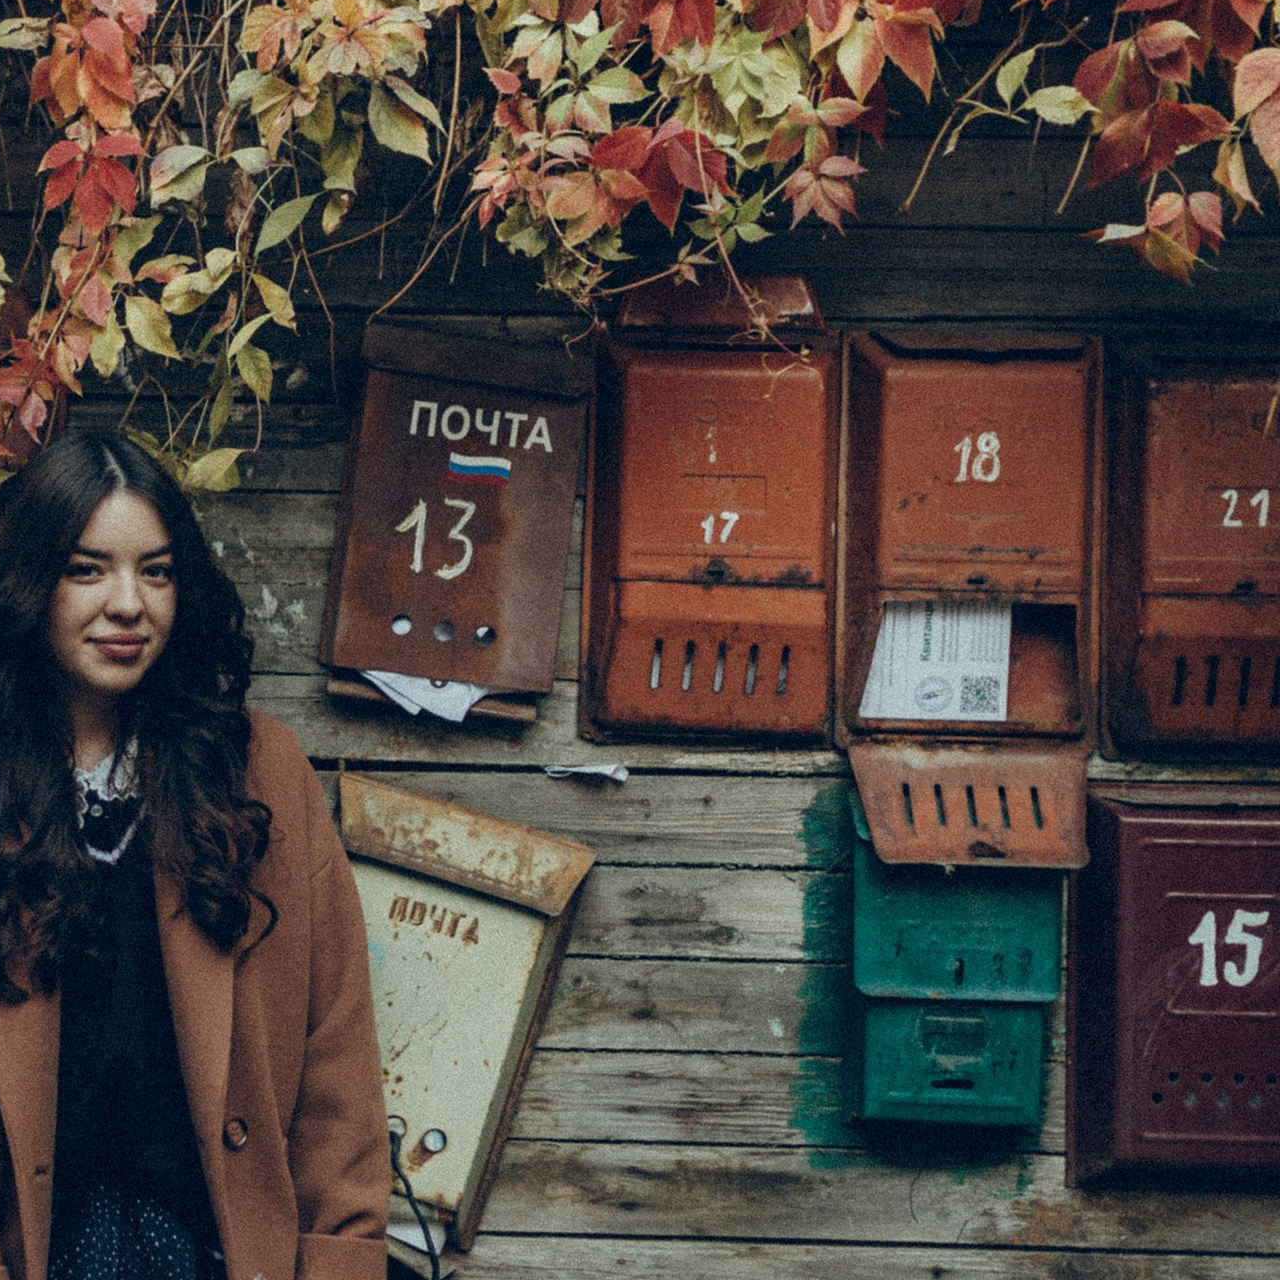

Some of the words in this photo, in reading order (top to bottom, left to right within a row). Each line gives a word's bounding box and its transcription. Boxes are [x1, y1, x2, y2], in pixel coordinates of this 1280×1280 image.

[409, 401, 553, 452] ПОЧТА
[954, 432, 1001, 482] 18
[701, 511, 739, 544] 17
[1221, 489, 1269, 527] 21
[396, 498, 476, 578] 13
[389, 896, 479, 946] ПОЧТА
[1188, 909, 1269, 987] 15
